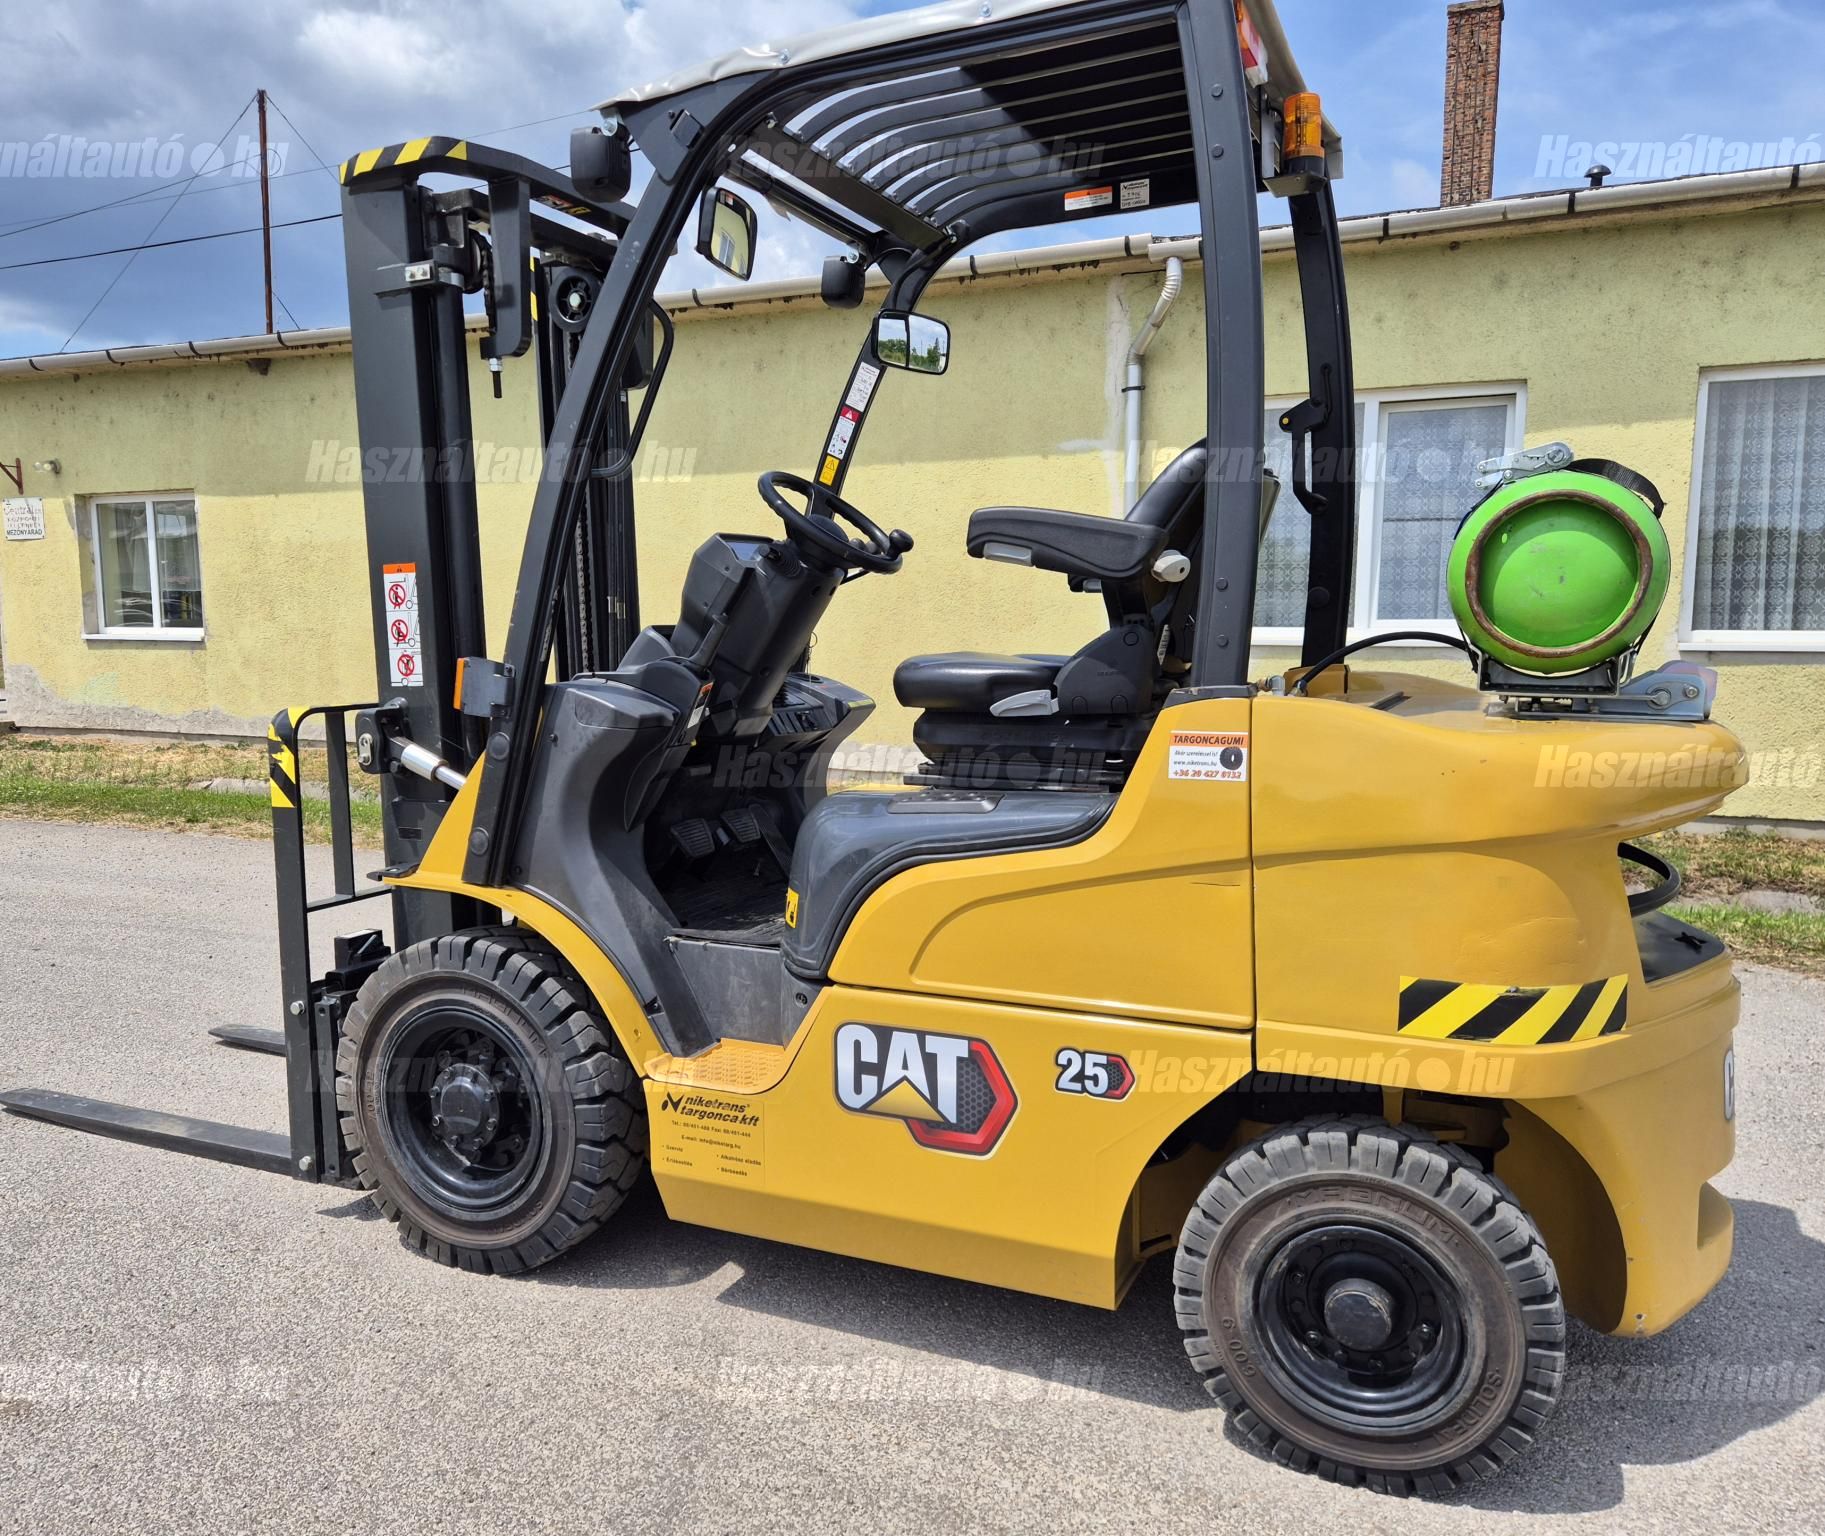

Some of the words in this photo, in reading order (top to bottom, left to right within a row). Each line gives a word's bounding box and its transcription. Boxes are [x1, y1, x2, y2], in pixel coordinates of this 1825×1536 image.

[1173, 735, 1244, 746] TARGONCAGUMI
[836, 1023, 969, 1124] CAT
[1055, 1049, 1109, 1096] 25
[684, 1095, 746, 1113] niketrans
